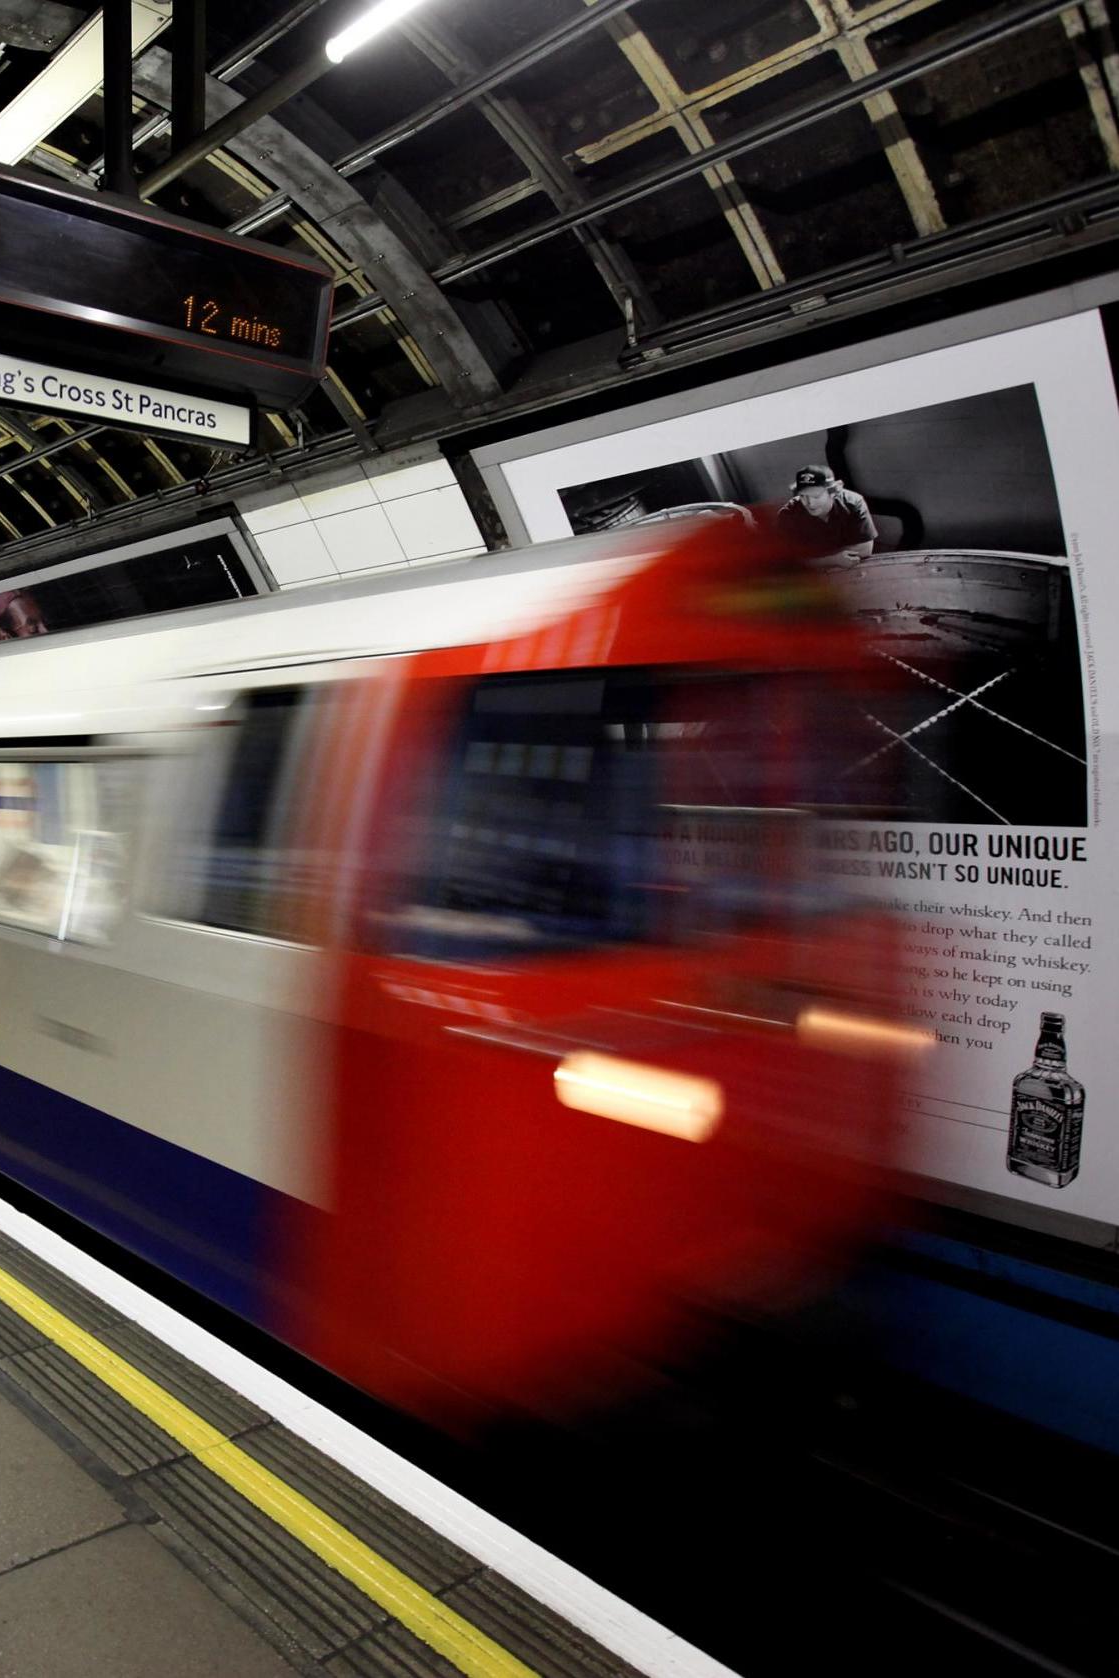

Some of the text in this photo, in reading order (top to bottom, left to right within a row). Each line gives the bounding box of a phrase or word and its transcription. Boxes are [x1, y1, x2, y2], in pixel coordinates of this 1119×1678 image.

[184, 296, 281, 346] 12 mins
[41, 375, 106, 407] Cross
[112, 389, 133, 412] St
[139, 394, 217, 429] Pancras
[869, 831, 919, 857] AGO,
[929, 832, 978, 857] OUR
[988, 835, 1087, 862] UNIQUE
[881, 862, 947, 881] WASN'T
[954, 865, 979, 883] SO
[987, 866, 1069, 889] UNIQUE.
[914, 901, 944, 914] their
[950, 904, 1013, 921] whiskey.
[1018, 908, 1052, 923] And
[1057, 912, 1092, 926] then
[921, 922, 954, 939] drop
[960, 926, 997, 940] what
[1003, 932, 1038, 946] they
[1044, 934, 1092, 949] called
[904, 945, 1091, 975] ways of making whiskey.
[934, 968, 949, 979] so
[953, 967, 968, 981] he
[973, 969, 1002, 986] kept
[1007, 978, 1026, 988] on
[1031, 979, 1073, 997] using
[923, 986, 934, 998] is
[938, 990, 971, 1004] why
[976, 994, 1018, 1012] today
[941, 1010, 973, 1026] each
[977, 1014, 1011, 1034] drop
[966, 1037, 994, 1052] you
